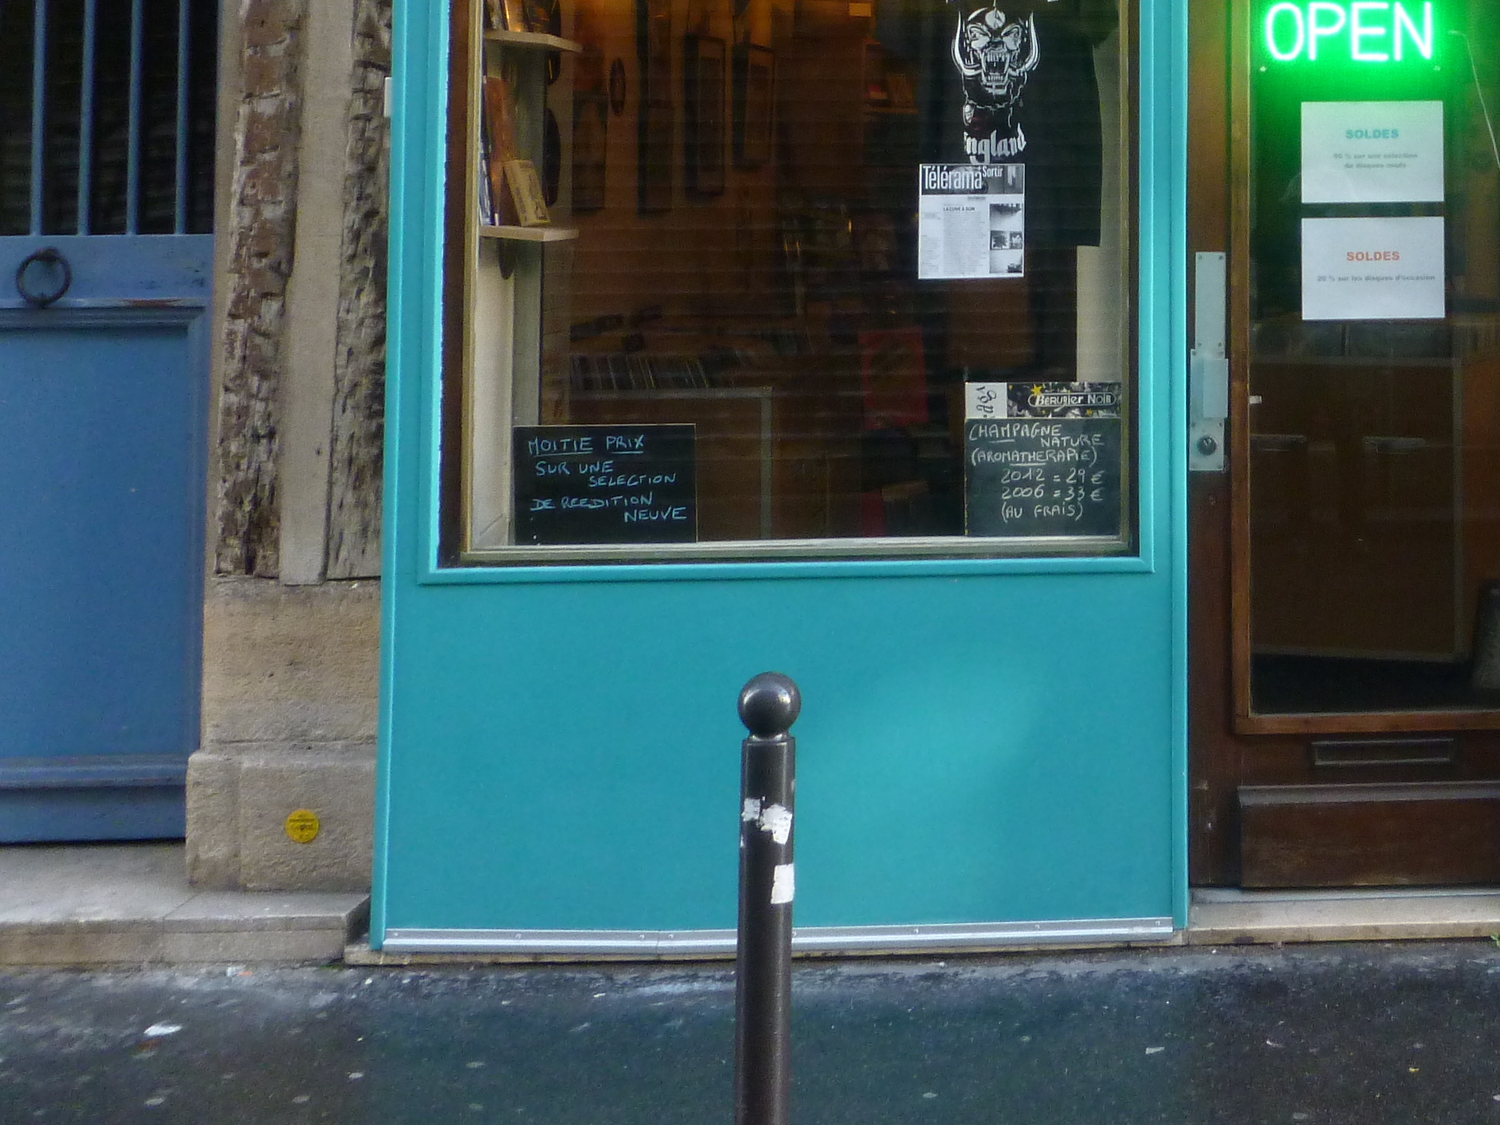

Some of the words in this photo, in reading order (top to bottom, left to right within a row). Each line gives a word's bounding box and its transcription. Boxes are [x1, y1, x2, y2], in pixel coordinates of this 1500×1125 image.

[1265, 1, 1433, 62] OPEN
[1346, 129, 1399, 139] SOLDES
[923, 165, 982, 190] Télérama
[982, 166, 1004, 177] Sortir
[1346, 251, 1400, 261] SOLDES
[969, 422, 1061, 441] CHAMPAGNE
[528, 436, 593, 454] MOITIE
[606, 434, 644, 451] PRIX
[1041, 434, 1105, 448] NATURE
[535, 461, 570, 476] SUR
[579, 460, 614, 474] UNE
[1001, 468, 1046, 484] 2012
[588, 473, 676, 487] SELECTION
[1002, 484, 1045, 500] 2006
[1065, 488, 1085, 501] 33
[530, 498, 555, 511] DE
[561, 492, 653, 509] REEDITION
[624, 506, 687, 523] NEUVE
